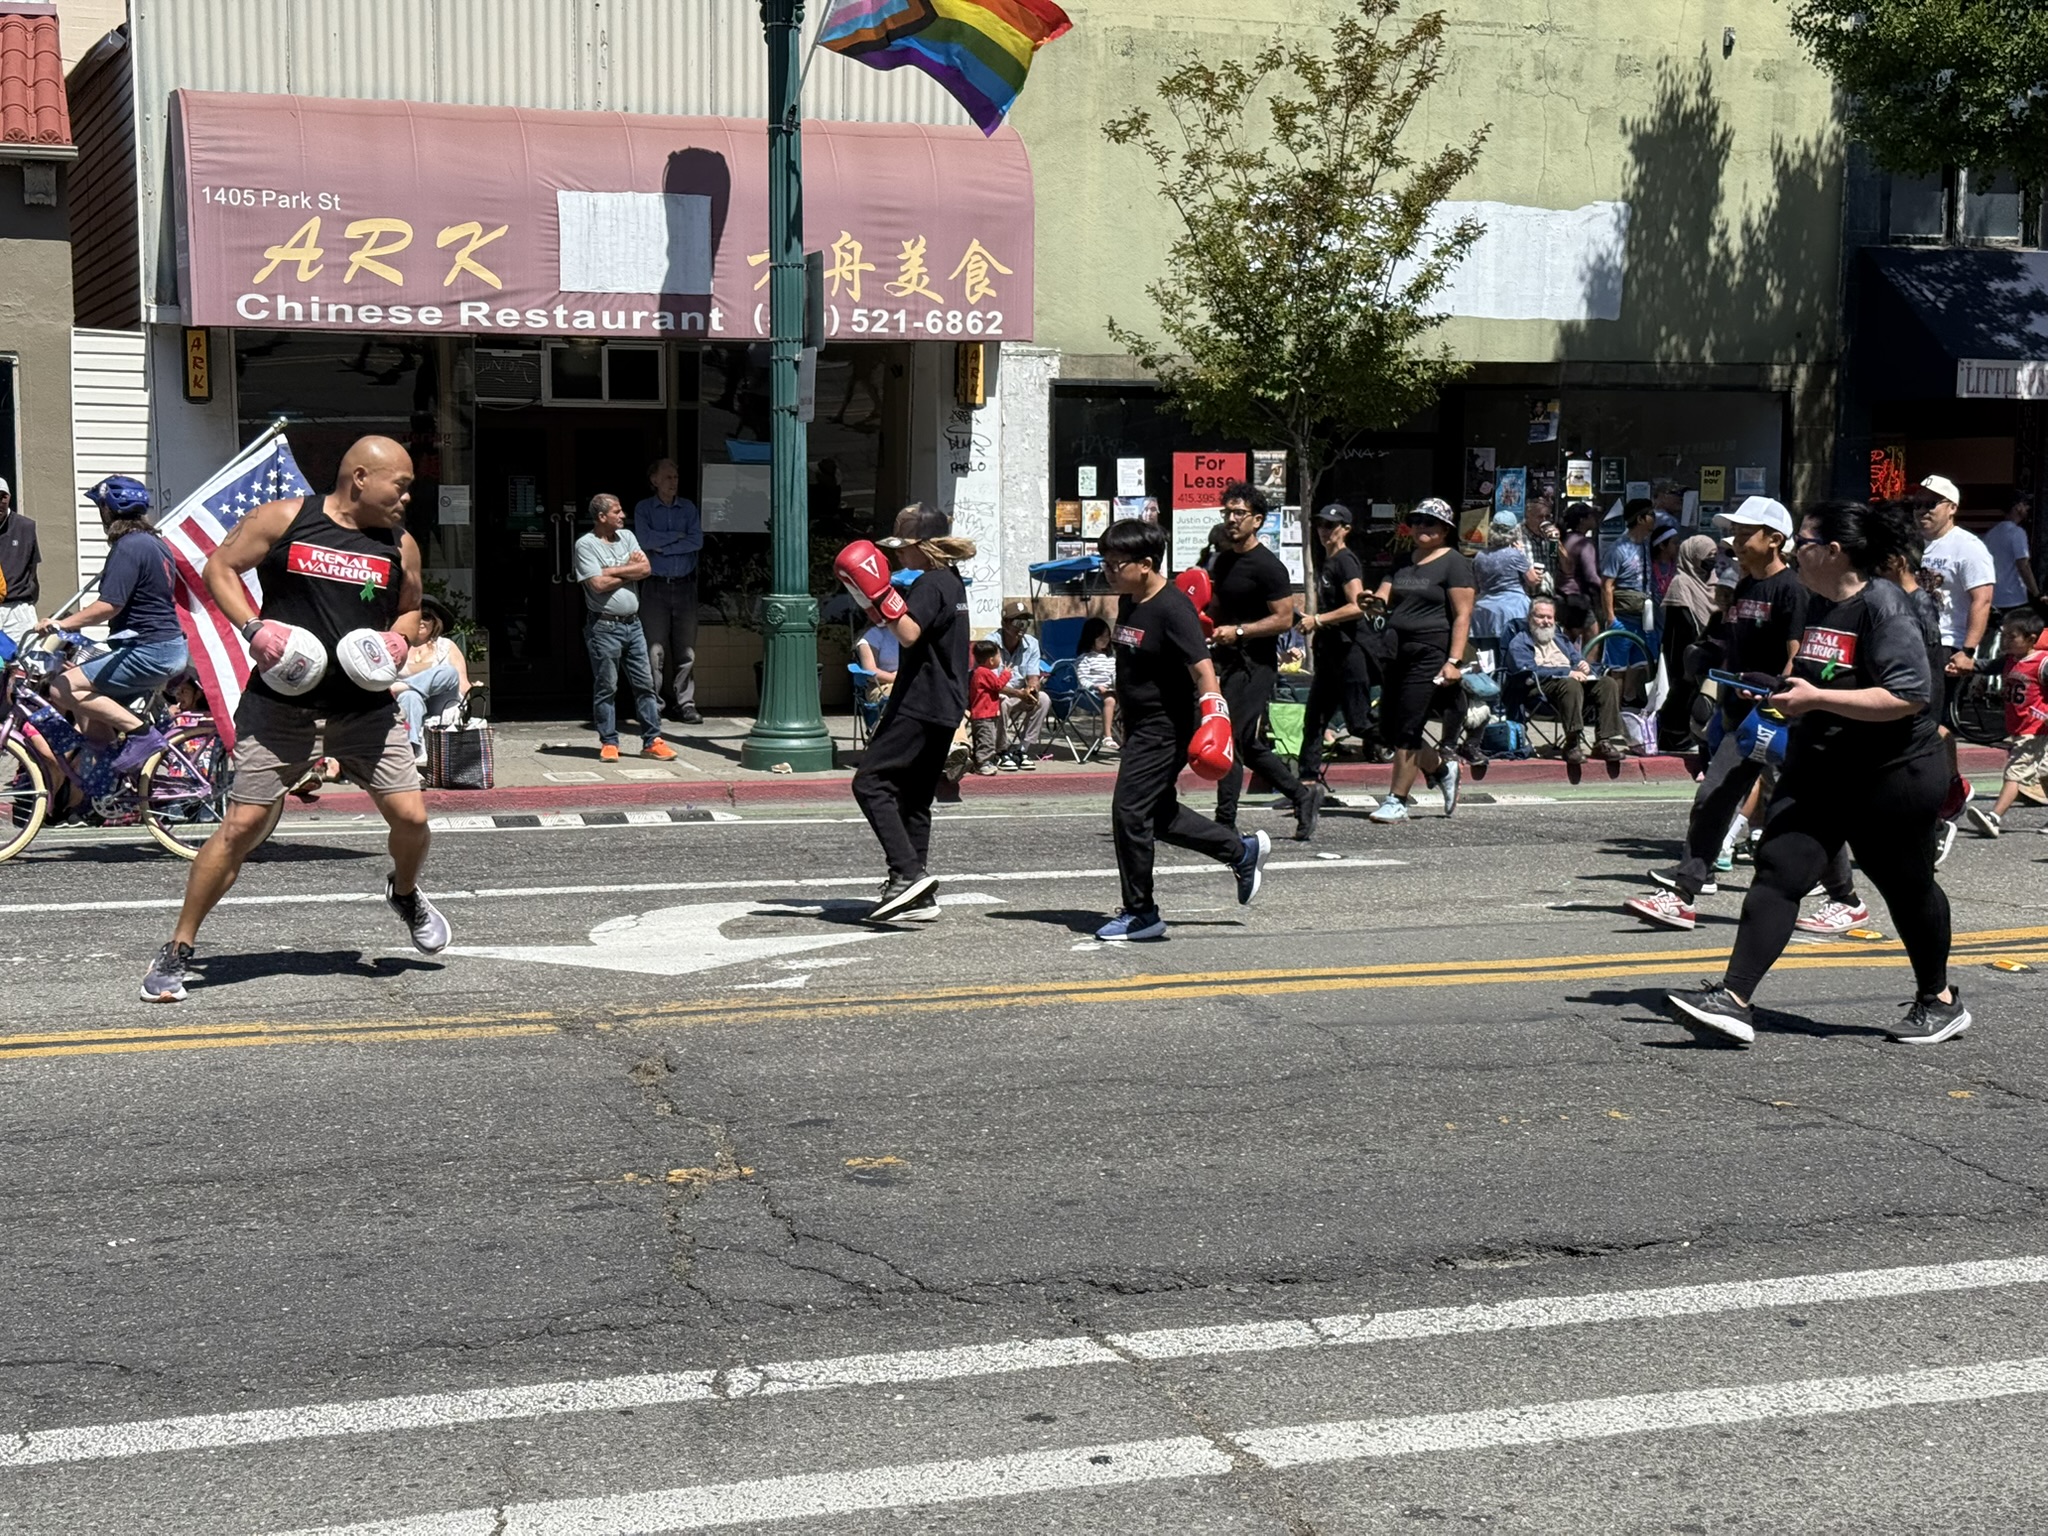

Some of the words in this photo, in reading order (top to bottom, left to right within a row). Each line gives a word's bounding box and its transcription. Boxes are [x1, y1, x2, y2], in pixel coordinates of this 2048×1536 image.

[202, 186, 256, 207] 1405
[262, 190, 312, 209] Park
[318, 192, 341, 211] St
[252, 216, 508, 290] ARK
[236, 293, 443, 326] Chinese
[460, 301, 724, 331] Restaurant
[851, 309, 1003, 335] 521-6862
[190, 336, 205, 390] ARK
[1195, 456, 1226, 471] For
[1704, 469, 1721, 478] IMP
[1184, 473, 1235, 489] Lease
[1178, 493, 1223, 505] 415.395.
[1176, 516, 1201, 525] Justin
[297, 558, 383, 583] WARRIOR
[311, 550, 373, 571] RENAL
[1802, 643, 1846, 661] ARRIOR
